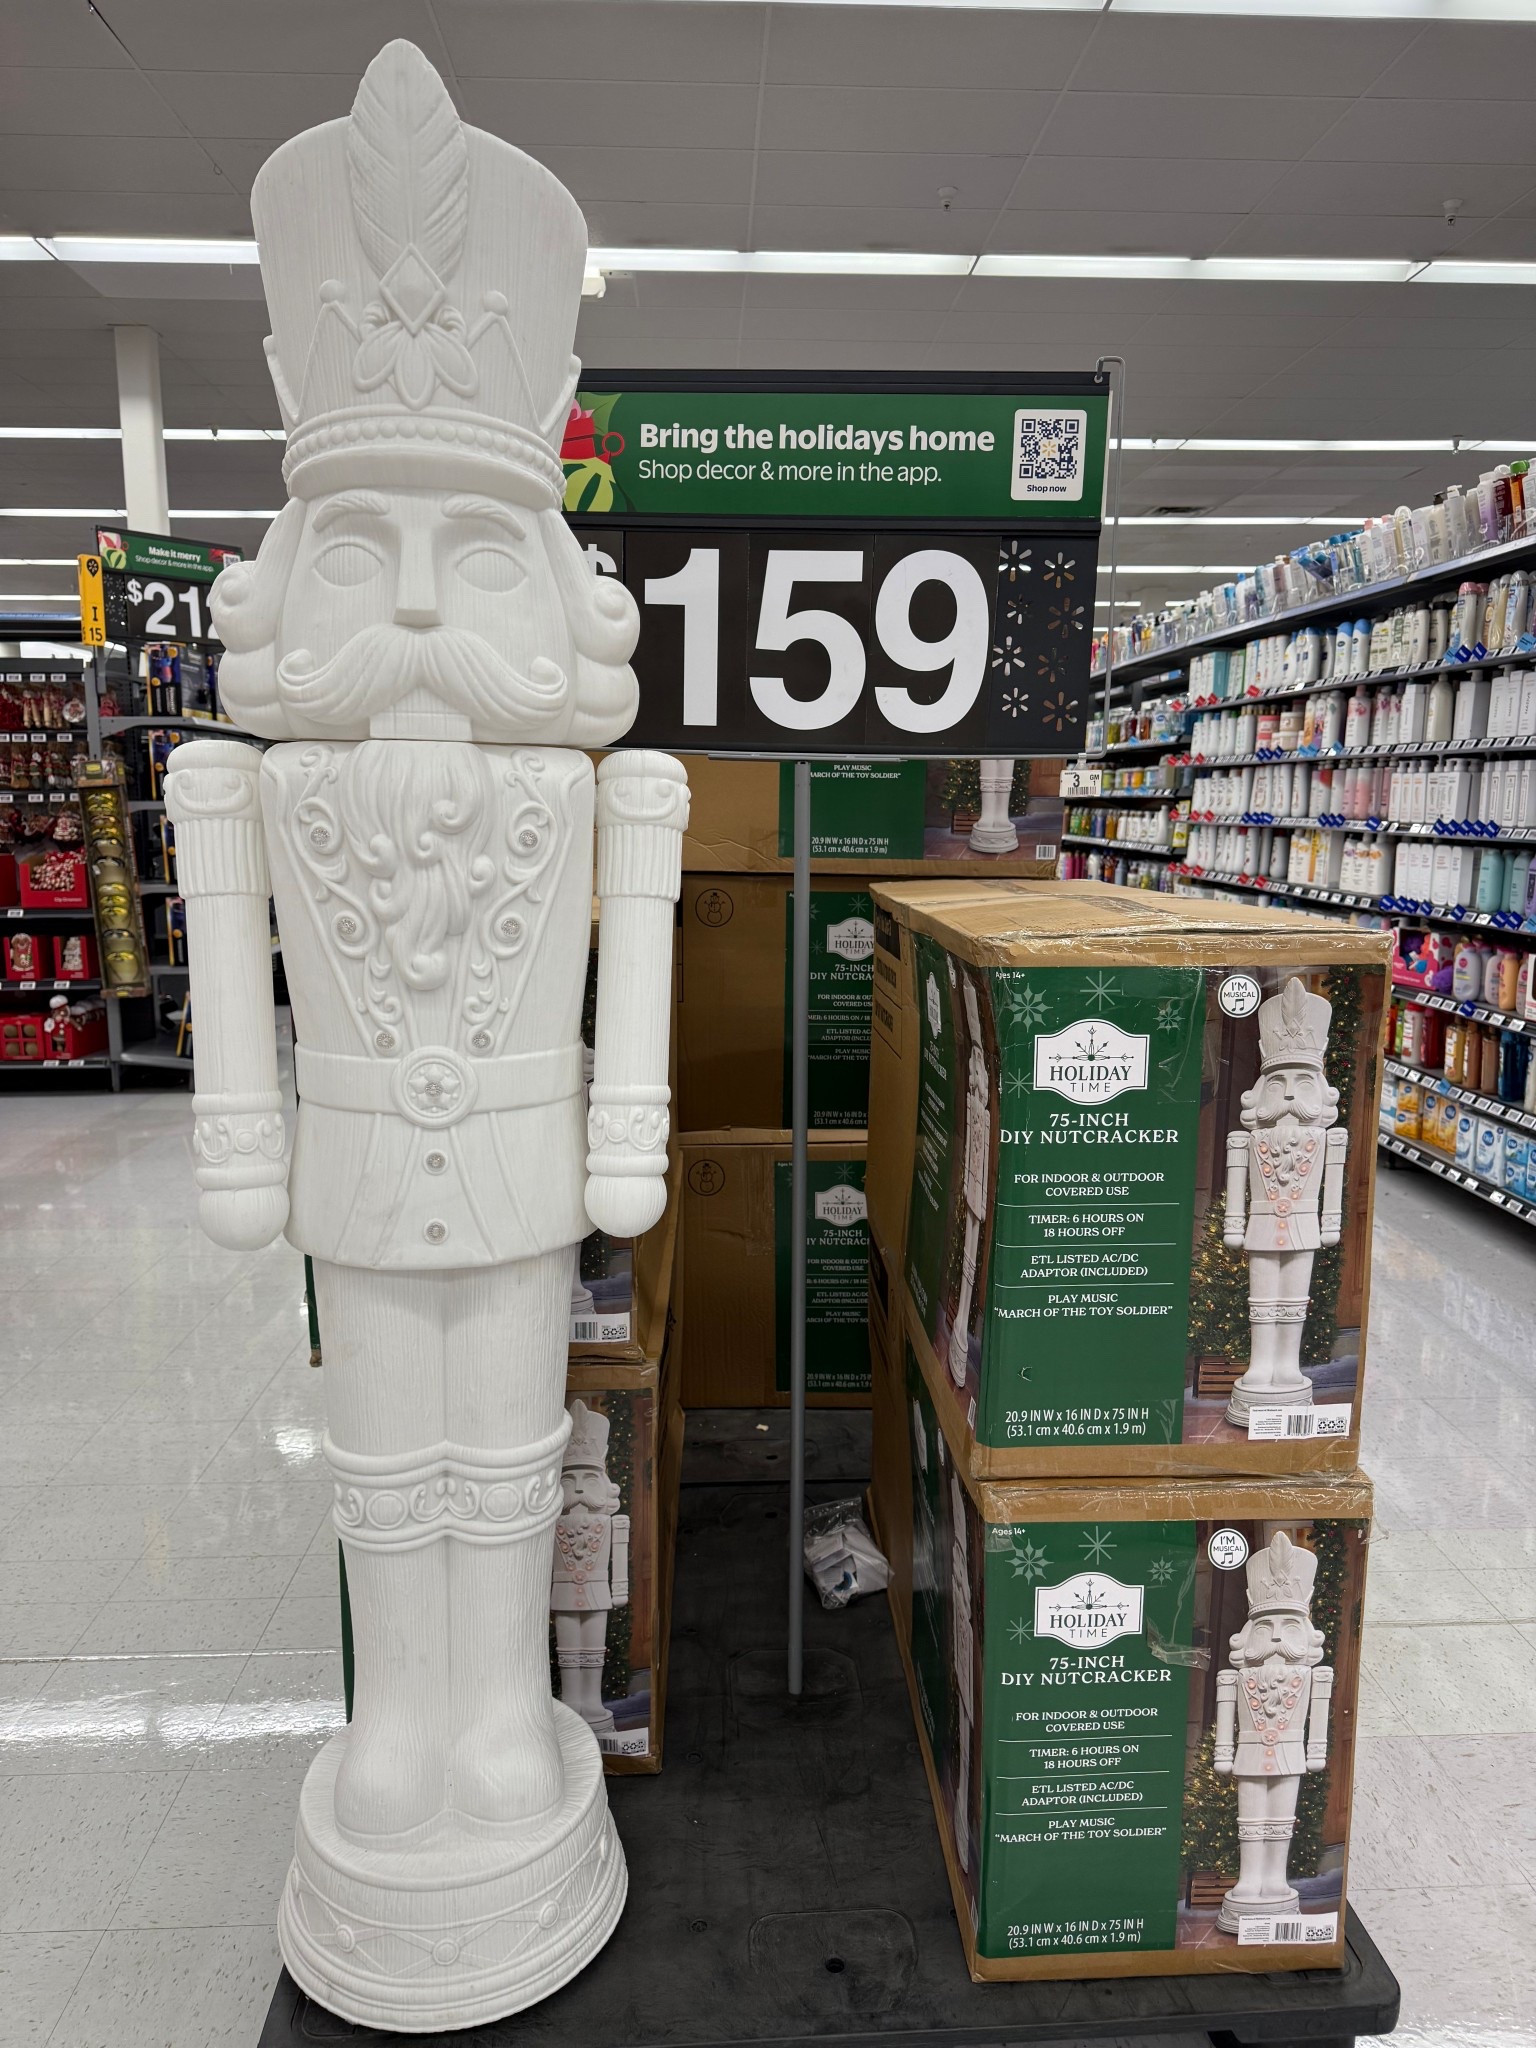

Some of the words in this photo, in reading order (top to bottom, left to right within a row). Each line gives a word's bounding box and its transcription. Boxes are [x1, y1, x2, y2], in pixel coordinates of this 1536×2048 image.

[641, 423, 718, 453] Bring
[724, 424, 773, 449] the
[780, 424, 903, 455] holidays
[910, 425, 994, 451] home
[639, 460, 692, 483] Shop
[697, 460, 756, 480] decor
[761, 461, 774, 480] &
[779, 465, 832, 481] more
[838, 462, 854, 481] in
[860, 462, 893, 481] the
[898, 467, 941, 485] app.
[1026, 483, 1046, 494] Shop
[1047, 485, 1067, 493] now
[135, 555, 150, 564] Shop
[148, 546, 170, 558] Make
[170, 549, 177, 558] it
[177, 551, 201, 563] merry
[89, 628, 103, 642] 15
[1073, 774, 1080, 788] 3
[835, 940, 874, 949] HOLIDAY
[835, 964, 874, 972] 75-INCH
[810, 972, 828, 980] DIY
[830, 972, 874, 981] NUTCRA
[1231, 981, 1248, 991] I'M
[1050, 1066, 1131, 1081] HOLIDAY
[1070, 1083, 1110, 1092] TIME
[1050, 1113, 1128, 1127] 75-INCH
[1001, 1129, 1033, 1144] DIY
[1041, 1130, 1178, 1144] NUTCRACKER
[1015, 1174, 1038, 1183] FOR
[1042, 1174, 1088, 1183] INDOOR
[1092, 1173, 1100, 1182] &
[1104, 1173, 1164, 1182] OUTDOOR
[1046, 1187, 1103, 1196] COVERED
[1106, 1187, 1129, 1196] USE
[823, 1206, 863, 1215] HOLIDAY
[1029, 1215, 1069, 1224] TIMER:
[1073, 1215, 1079, 1223] 6
[1082, 1214, 1124, 1223] HOURS
[1127, 1213, 1144, 1222] ON
[823, 1229, 863, 1237] 75-INCH
[1044, 1228, 1055, 1237] 18
[1058, 1228, 1099, 1237] HOURS
[1102, 1227, 1125, 1236] OFF
[1032, 1255, 1054, 1264] ETL
[1057, 1254, 1099, 1263] LISTED
[1102, 1254, 1138, 1263] AC/DC
[1021, 1268, 1077, 1278] ADAPTOR
[1080, 1267, 1148, 1277] (INCLUDED)
[1048, 1295, 1078, 1303] PLAY
[1081, 1294, 1118, 1303] MUSIC
[1044, 1308, 1059, 1317] OF
[1062, 1308, 1086, 1316] THE
[1089, 1307, 1114, 1315] TOY
[1006, 1411, 1027, 1423] 20.9
[1031, 1410, 1040, 1421] IN
[1044, 1410, 1054, 1421] W
[1056, 1412, 1062, 1420] x
[1066, 1409, 1077, 1420] 16
[1081, 1409, 1090, 1420] IN
[1094, 1408, 1101, 1420] D
[1104, 1411, 1109, 1420] x
[1113, 1408, 1124, 1420] 75
[1128, 1408, 1138, 1419] IN
[1142, 1408, 1148, 1419] H
[1008, 1425, 1031, 1438] (53.1
[1036, 1427, 1050, 1436] cm
[1054, 1427, 1059, 1435] x
[1062, 1424, 1084, 1435] 40.6
[1087, 1426, 1101, 1435] cm
[1105, 1426, 1110, 1434] x
[1114, 1423, 1129, 1434] 1.9
[1132, 1422, 1145, 1435] m)
[992, 1528, 1012, 1536] Ages
[1220, 1536, 1236, 1545] I'M
[1050, 1614, 1126, 1628] HOLIDAY
[1069, 1628, 1108, 1638] TIME
[1050, 1656, 1124, 1669] 75-INCH
[1002, 1673, 1034, 1685] DIY
[1041, 1670, 1171, 1685] NUTCRACKER
[1016, 1713, 1039, 1721] FOR
[1042, 1711, 1086, 1720] INDOOR
[1090, 1710, 1097, 1718] &
[1101, 1708, 1157, 1717] OUTDOOR
[1046, 1722, 1100, 1732] COVERED
[1103, 1721, 1124, 1730] USE
[1029, 1748, 1068, 1757] TIMER:
[1081, 1746, 1120, 1755] HOURS
[1123, 1745, 1138, 1753] ON
[1044, 1761, 1054, 1769] 18
[1058, 1759, 1096, 1768] HOURS
[1100, 1758, 1121, 1766] OFF
[1032, 1785, 1054, 1793] ETL
[1057, 1783, 1096, 1792] LISTED
[1099, 1781, 1134, 1790] AC/DC
[1022, 1796, 1076, 1806] ADAPTOR
[1079, 1792, 1142, 1804] (INCLUDED)
[1049, 1820, 1076, 1829] PLAY
[1080, 1818, 1114, 1827] MUSIC
[1044, 1833, 1059, 1841] OF
[1062, 1831, 1085, 1840] THE
[1088, 1830, 1110, 1838] TOY
[1008, 1925, 1028, 1936] 20.9
[1032, 1924, 1041, 1934] IN
[1044, 1923, 1054, 1933] W
[1065, 1922, 1076, 1932] 16
[1079, 1921, 1088, 1931] IN
[1092, 1920, 1098, 1931] D
[1110, 1920, 1120, 1930] 75
[1124, 1919, 1133, 1929] IN
[1137, 1919, 1143, 1929] H
[1009, 1937, 1032, 1949] (53.1
[1037, 1938, 1050, 1946] cm
[1054, 1937, 1058, 1945] x
[1061, 1934, 1082, 1944] 40.6
[1085, 1936, 1099, 1944] cm
[1102, 1935, 1107, 1943] x
[1111, 1932, 1125, 1942] 1.9
[1128, 1931, 1140, 1943] m)
